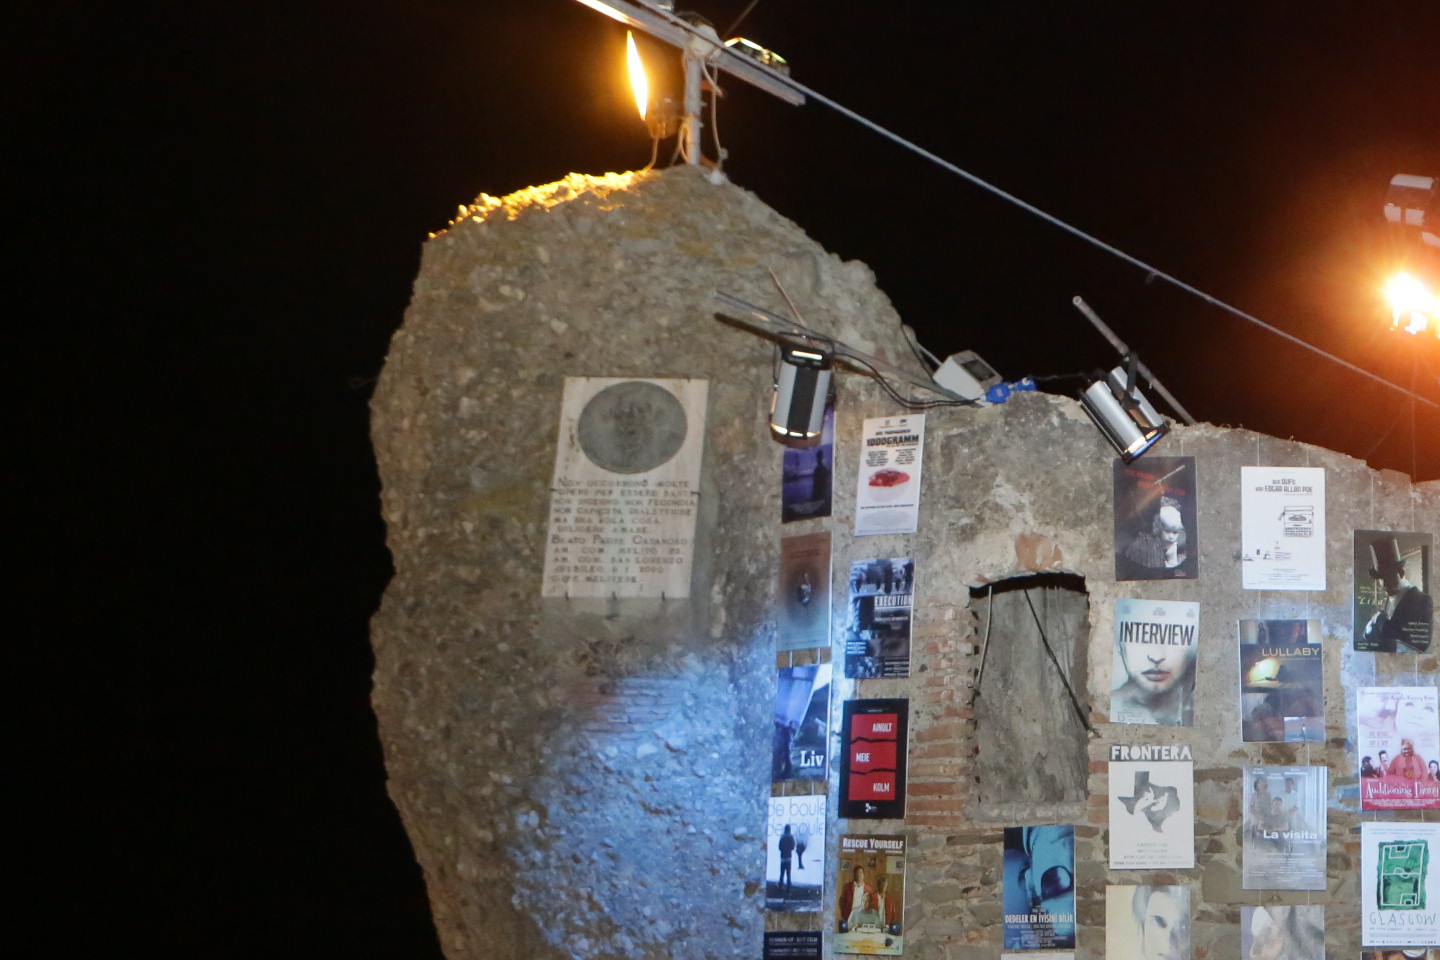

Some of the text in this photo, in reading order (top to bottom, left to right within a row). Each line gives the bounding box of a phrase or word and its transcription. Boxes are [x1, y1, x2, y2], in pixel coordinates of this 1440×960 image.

[1120, 621, 1195, 646] INTERVIEW
[1262, 647, 1320, 657] LULLABY
[1111, 745, 1193, 761] FRONTERA
[1263, 829, 1318, 840] La visita
[1369, 911, 1437, 927] GLASGOW
